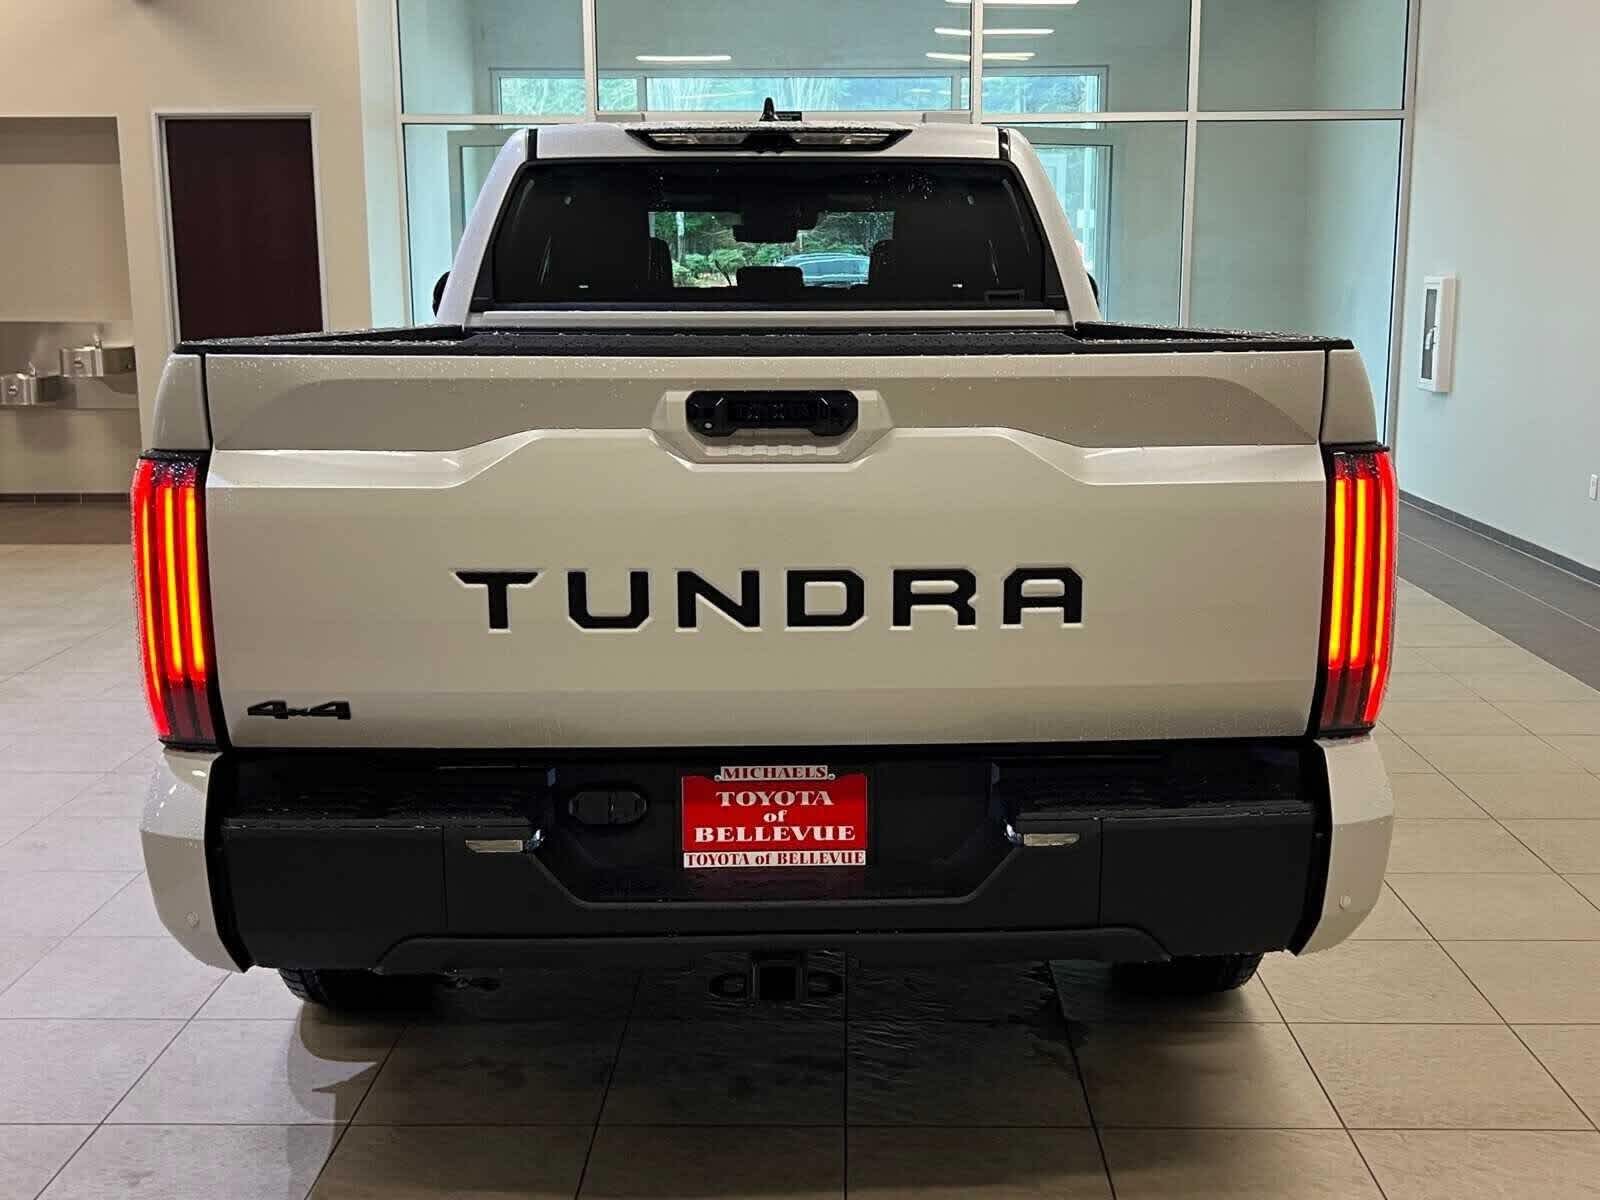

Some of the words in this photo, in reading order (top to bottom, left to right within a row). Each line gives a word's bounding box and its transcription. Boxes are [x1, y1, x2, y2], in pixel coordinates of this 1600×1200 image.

[451, 566, 1084, 631] TUNDRA
[247, 700, 352, 720] 4x4
[723, 767, 827, 779] MICHAELS
[716, 790, 834, 807] TOYOTA
[763, 810, 788, 823] of
[694, 825, 856, 843] BELLEVUE
[686, 853, 750, 866] TOYOTA
[755, 853, 770, 865] of
[777, 852, 864, 865] BELLEVUE
